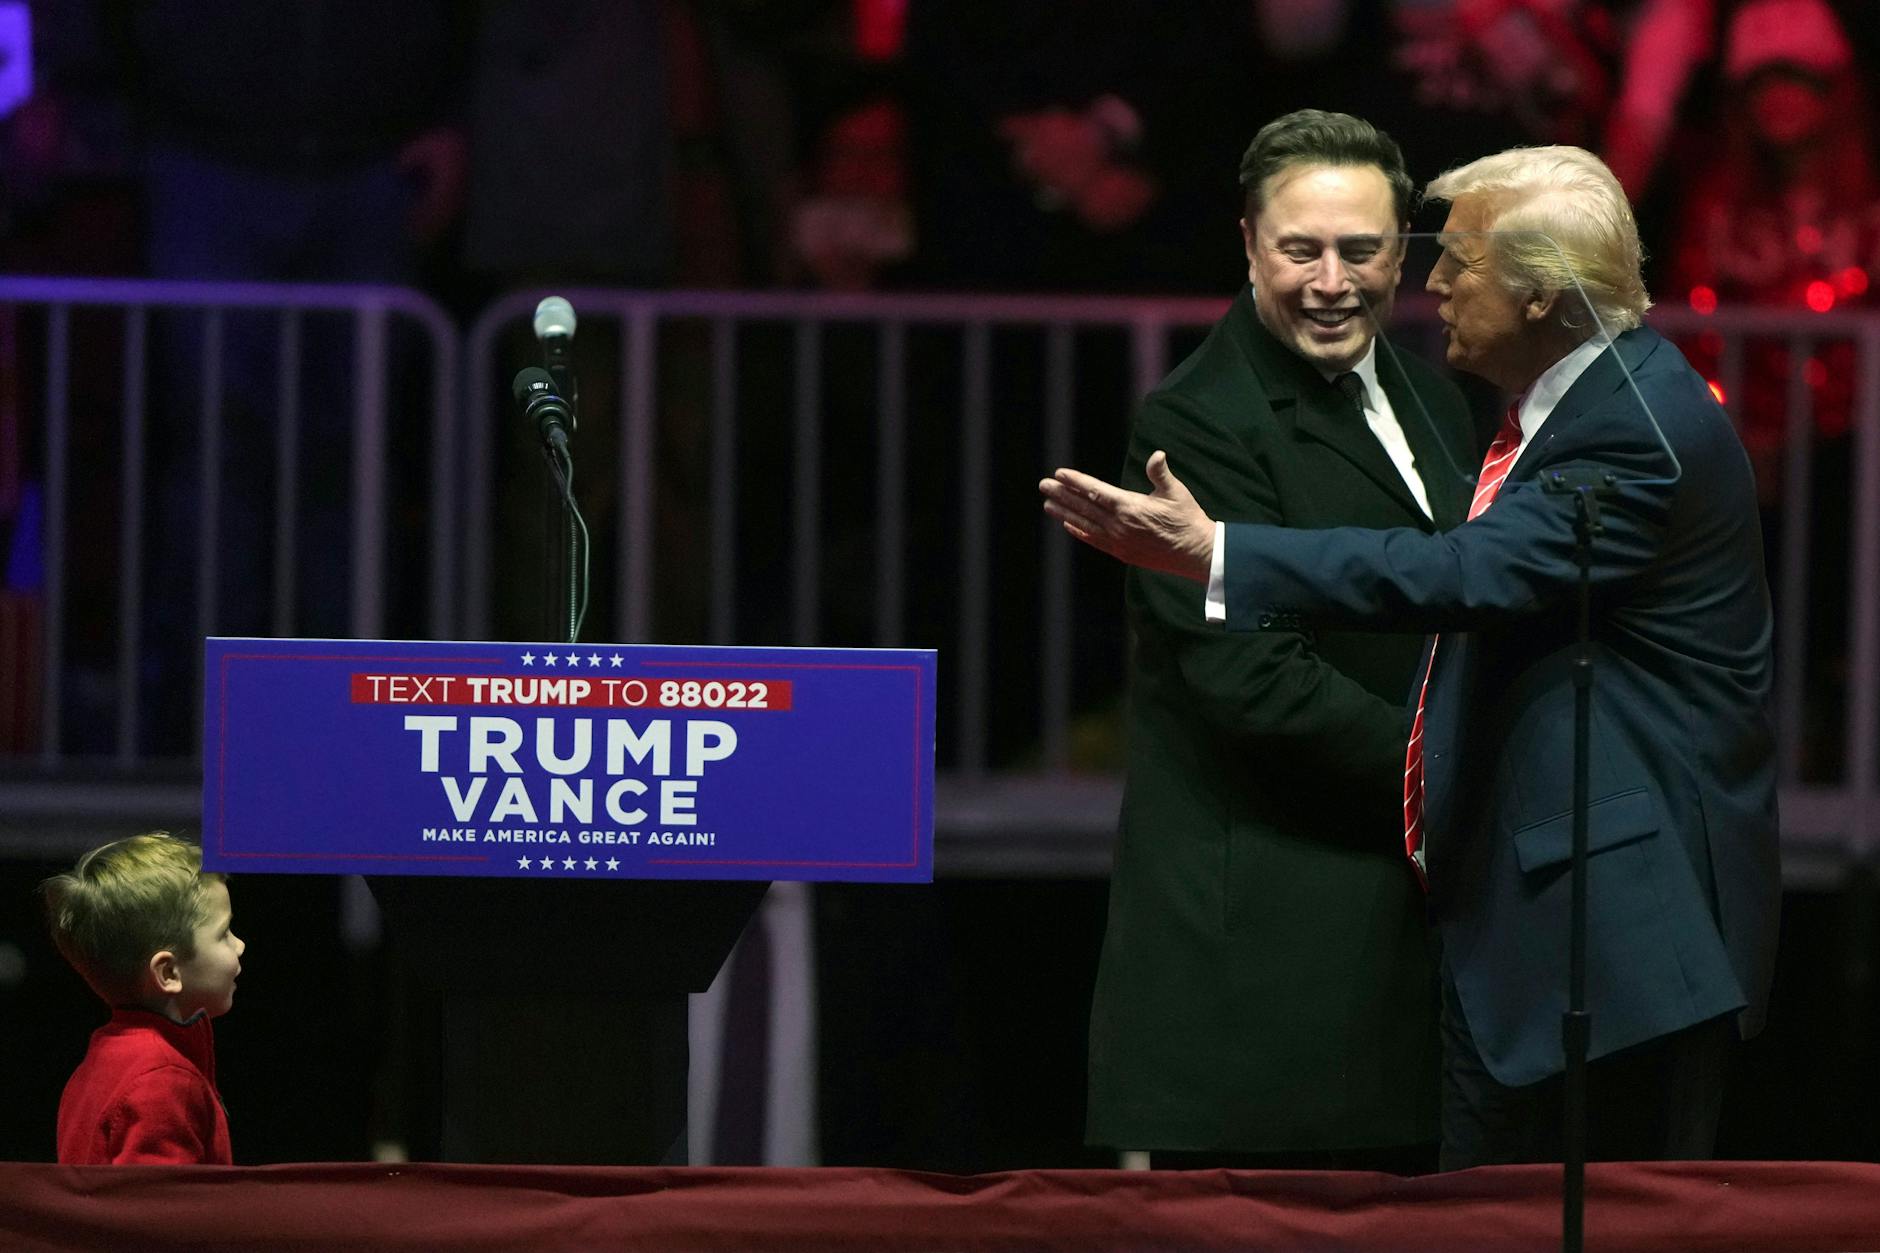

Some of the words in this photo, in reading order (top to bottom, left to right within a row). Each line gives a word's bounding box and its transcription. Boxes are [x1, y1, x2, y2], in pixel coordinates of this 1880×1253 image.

[367, 676, 456, 703] TEXT
[467, 677, 592, 705] TRUMP
[601, 680, 648, 706] TO
[659, 681, 768, 708] 88022
[405, 716, 738, 777] TRUMP
[441, 777, 698, 826] VANCE
[422, 829, 477, 843] MAKE
[483, 829, 572, 844] AMERICA
[578, 831, 641, 845] GREAT
[647, 832, 716, 846] AGAIN!
